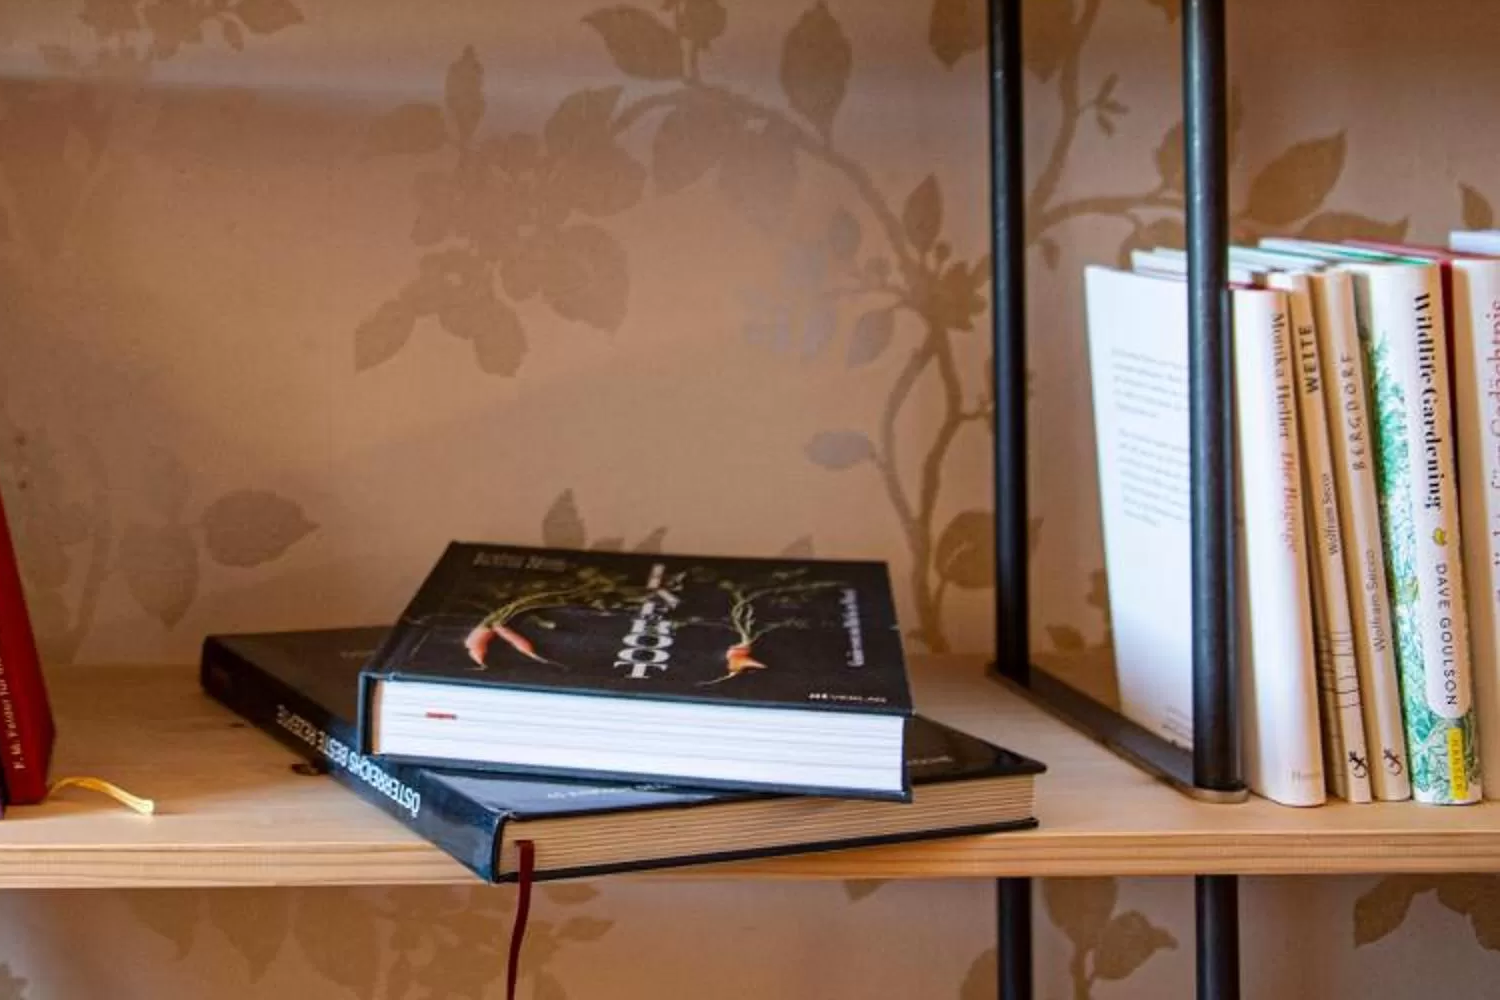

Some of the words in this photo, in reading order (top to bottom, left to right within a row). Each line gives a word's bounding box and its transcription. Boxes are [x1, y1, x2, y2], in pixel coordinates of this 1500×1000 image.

[1271, 312, 1289, 379] Monika
[1298, 325, 1319, 395] WEITE
[1413, 293, 1437, 384] Wildlife
[1340, 353, 1368, 472] BERGDORF
[1421, 388, 1445, 510] Gardening
[1322, 507, 1339, 556] Wolfram
[1434, 563, 1451, 609] DAVE
[1368, 593, 1386, 653] Wolfram
[1439, 617, 1458, 706] GOULSON
[1, 699, 20, 738] Felder
[315, 732, 348, 767] BESTE
